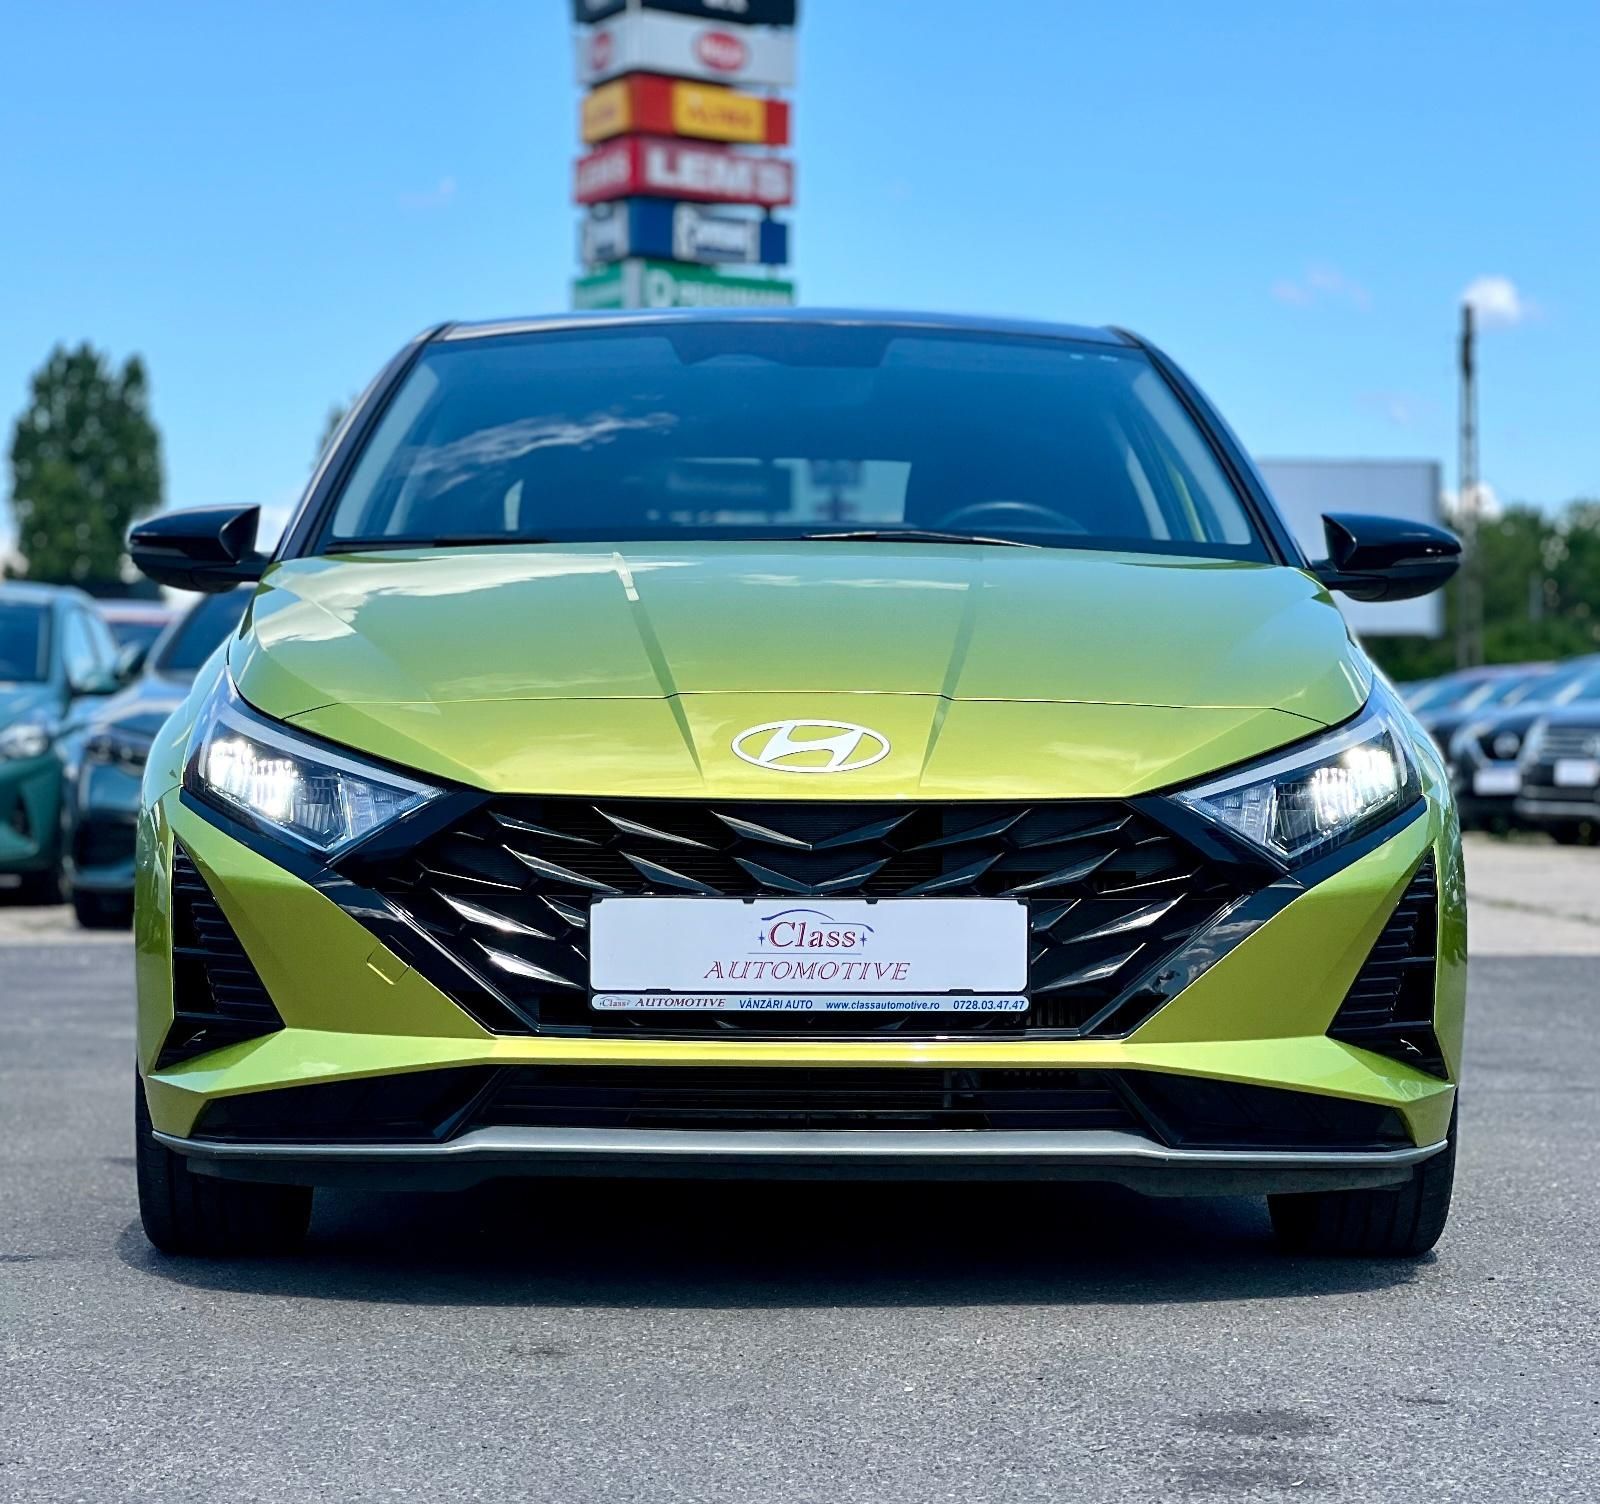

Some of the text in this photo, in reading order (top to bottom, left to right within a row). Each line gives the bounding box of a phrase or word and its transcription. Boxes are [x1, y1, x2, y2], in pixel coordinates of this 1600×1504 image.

[767, 921, 856, 948] Class
[703, 960, 911, 981] AUTOMOTIVE
[635, 998, 726, 1008] AUTOMOTIVE
[784, 1000, 814, 1010] AUTO
[825, 1000, 940, 1010] www.classautomotive.ro
[953, 1000, 1025, 1010] 0728.03.47.47
